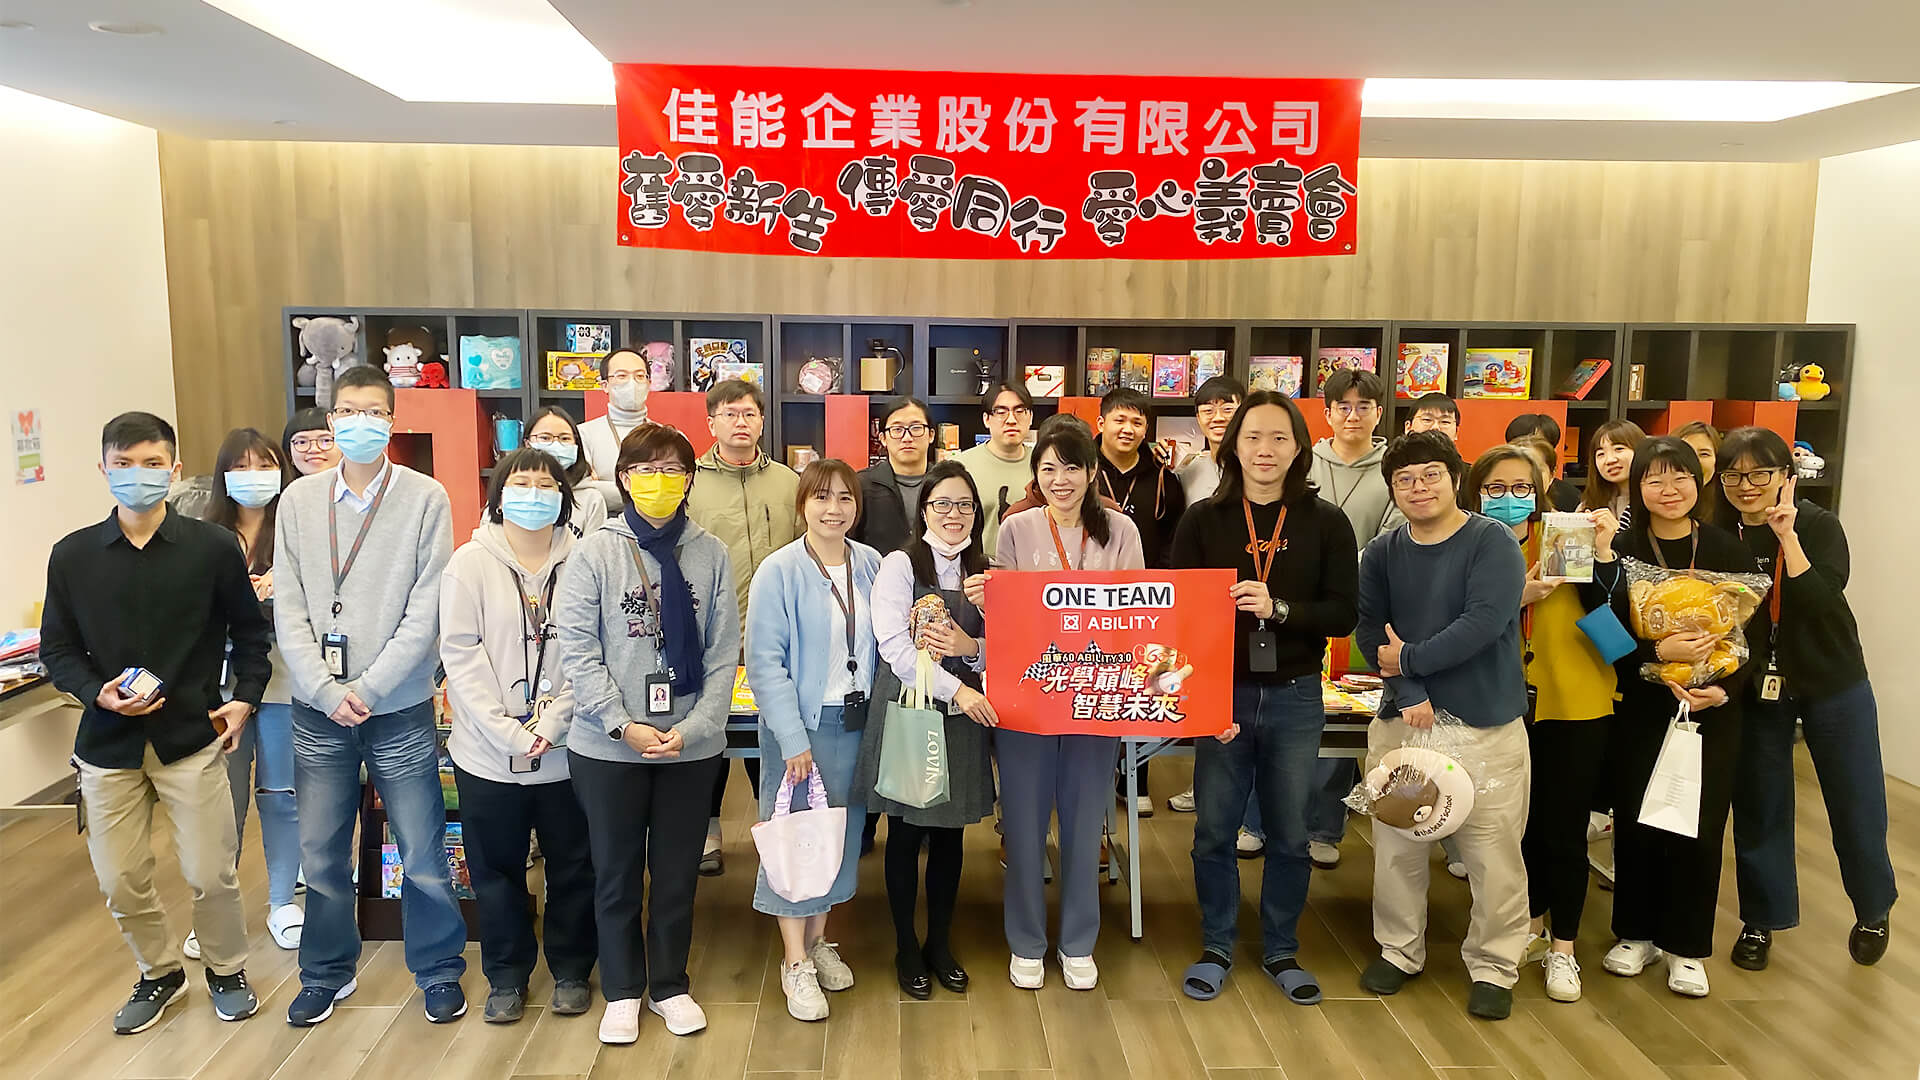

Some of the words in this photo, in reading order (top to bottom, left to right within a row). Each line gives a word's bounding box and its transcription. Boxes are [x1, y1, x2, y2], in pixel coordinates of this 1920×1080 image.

[662, 87, 1321, 156] 佳能企業股份有限公司
[621, 151, 837, 253] 舊愛新生
[839, 154, 1067, 253] 傳愛同行
[1082, 157, 1357, 247] 愛心義賣會
[1045, 587, 1096, 607] ONE
[1103, 586, 1171, 607] TEAM
[1087, 615, 1159, 631] ABILITY
[1076, 653, 1132, 664] ABILITY3.0
[1072, 692, 1185, 722] 智慧未來
[925, 729, 940, 785] LOVIN
